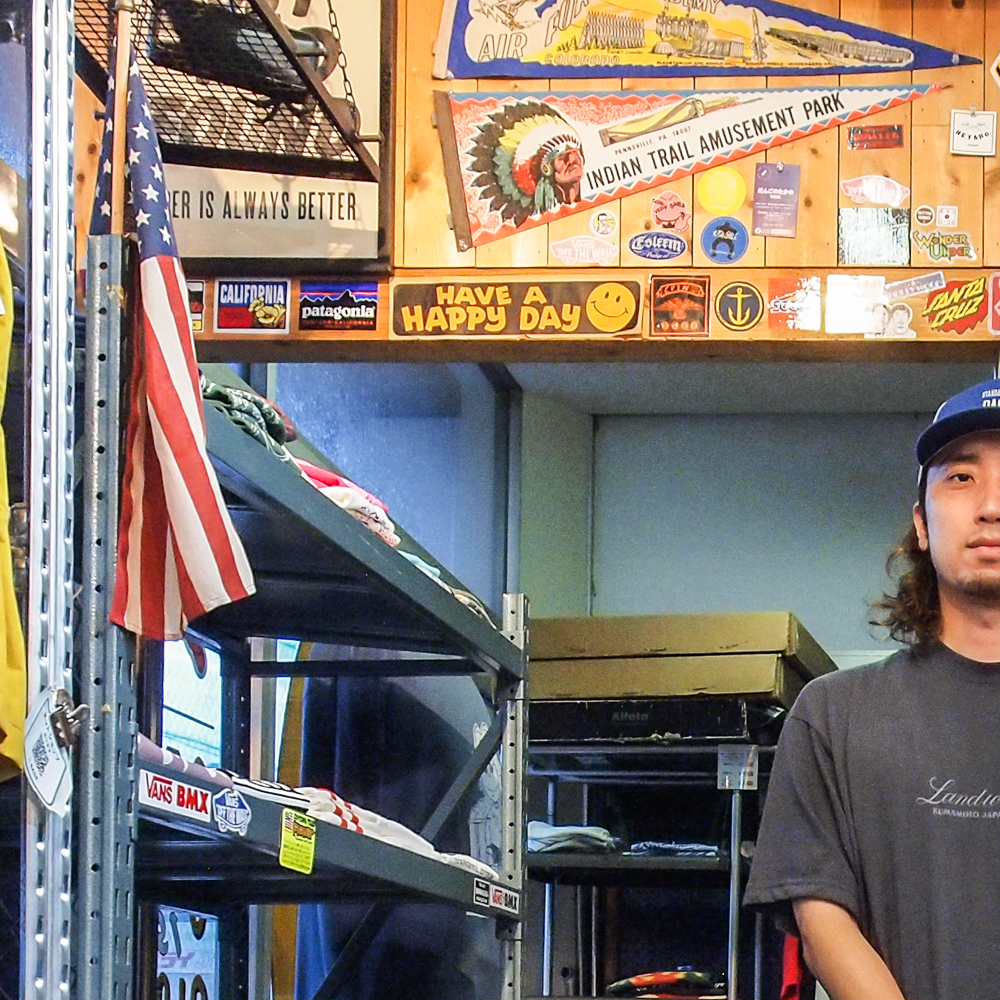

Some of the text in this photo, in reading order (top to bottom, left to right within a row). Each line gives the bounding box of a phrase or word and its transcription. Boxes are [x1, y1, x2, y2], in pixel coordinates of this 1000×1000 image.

[478, 32, 528, 62] AIR
[544, 53, 621, 64] COLORADO
[586, 92, 845, 191] INDIAN TRAIL AMUSEMENT PARK
[168, 190, 357, 221] ER IS ALWAYS BETTER
[912, 230, 969, 249] WONDER
[929, 246, 973, 261] UNDER
[220, 284, 285, 304] CALIFORNIA
[436, 285, 547, 306] HAVE A
[923, 277, 987, 315] SANTA
[301, 305, 375, 320] patagonia
[401, 304, 582, 332] HAPPY DAY
[930, 296, 986, 328] CRUZ
[145, 772, 209, 815] VANS BMX
[932, 807, 980, 818] KUMAMOTO
